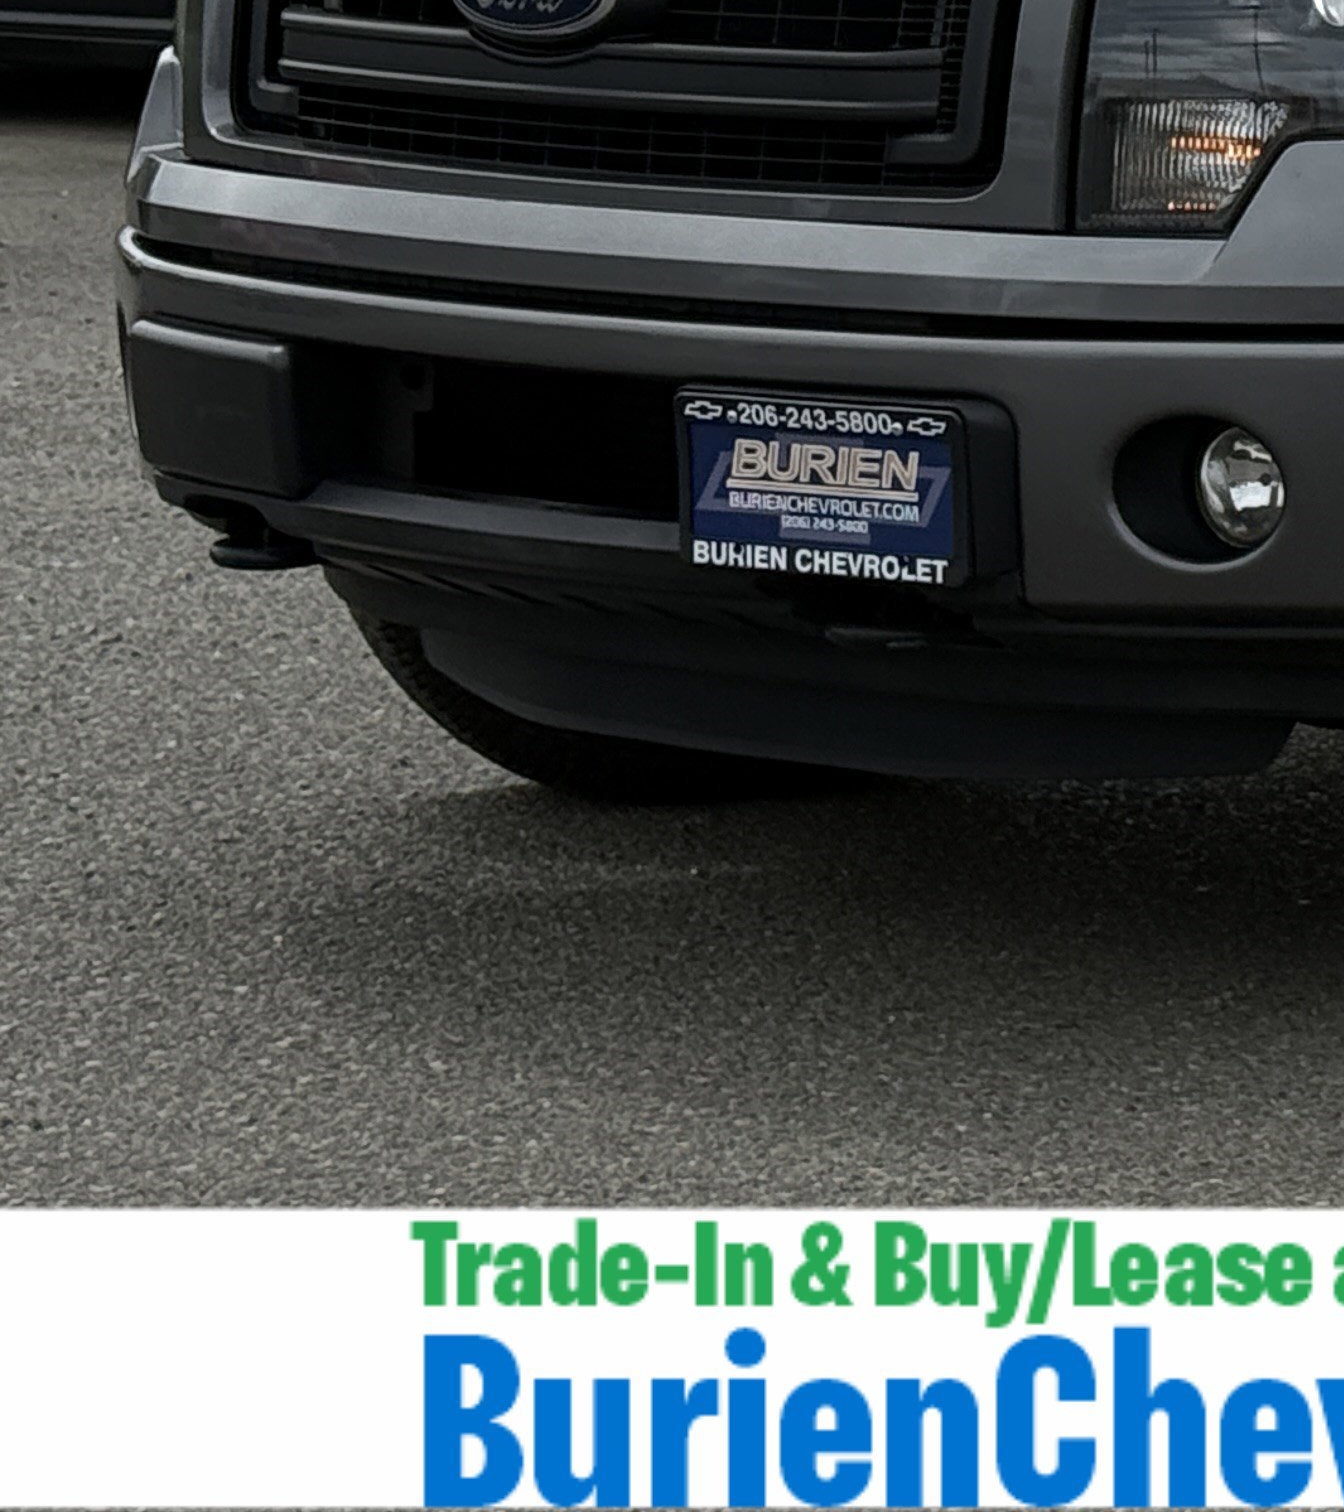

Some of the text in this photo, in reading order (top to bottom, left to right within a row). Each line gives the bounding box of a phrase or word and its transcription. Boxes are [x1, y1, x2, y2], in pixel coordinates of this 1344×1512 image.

[736, 402, 893, 435] 206-243-5800
[731, 438, 920, 491] BURIEN
[728, 491, 920, 523] BURIENCHEVROLET.COM
[693, 539, 949, 584] BURIEN CHEVROLET
